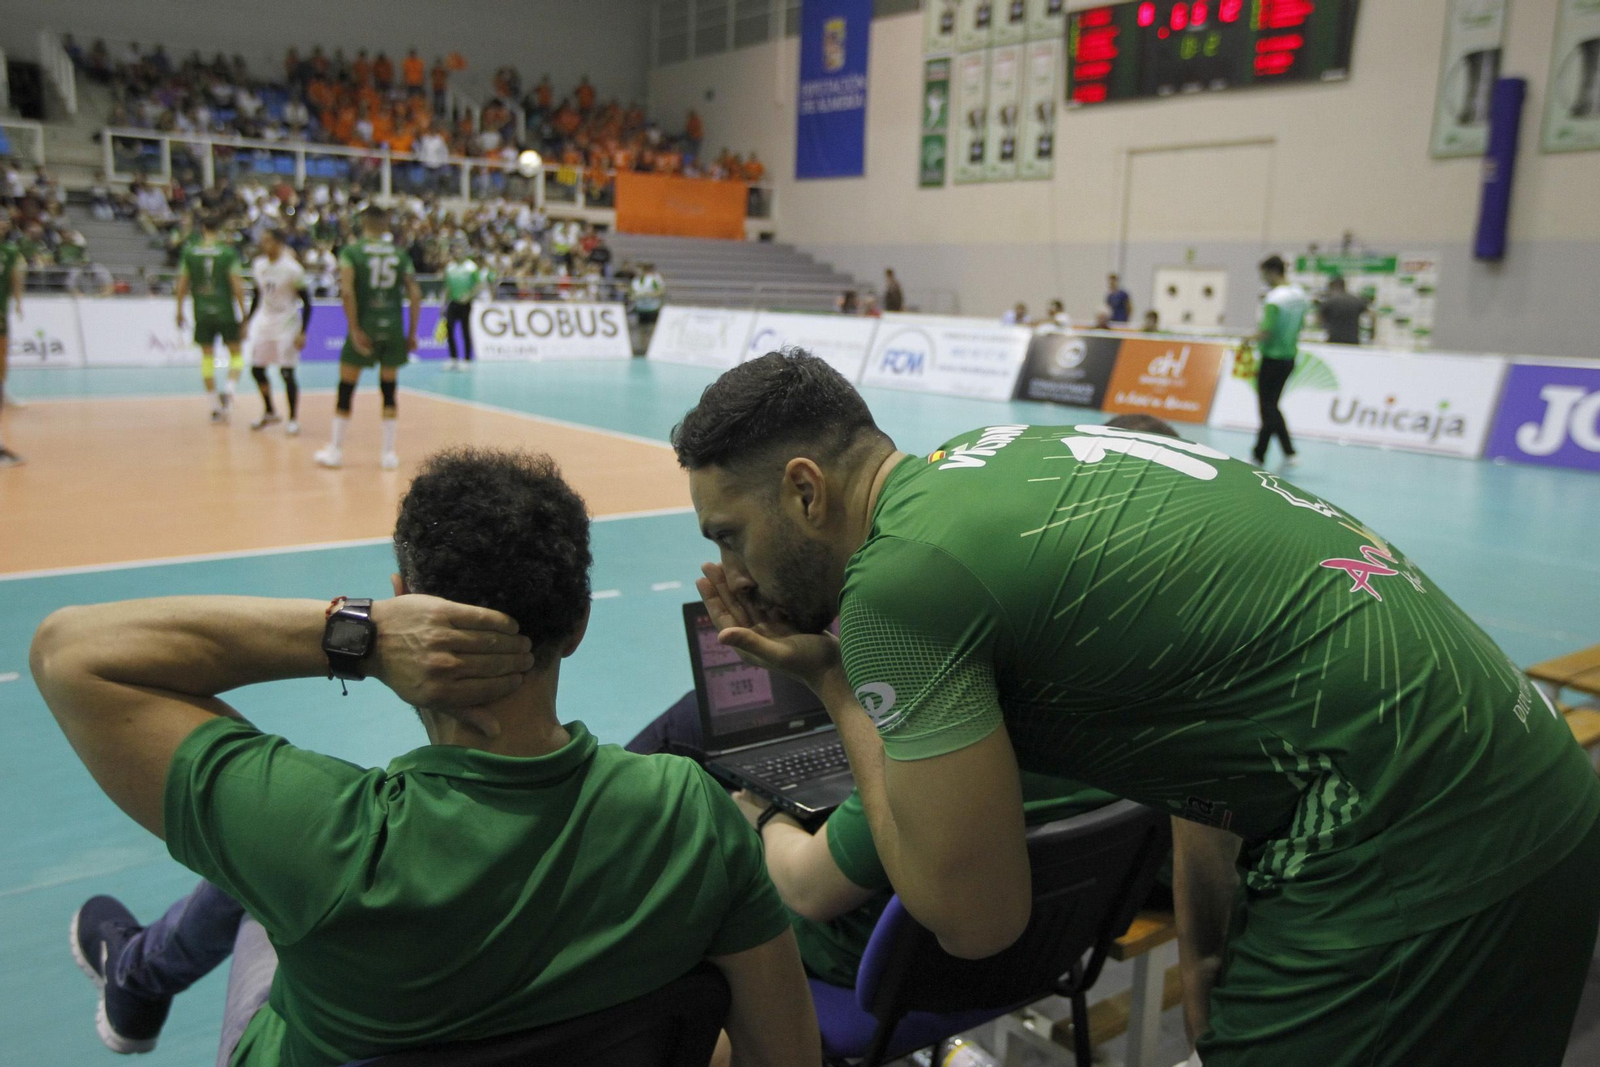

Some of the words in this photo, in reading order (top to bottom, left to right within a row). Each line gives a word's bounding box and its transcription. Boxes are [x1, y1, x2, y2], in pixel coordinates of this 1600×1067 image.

[367, 256, 400, 288] 15
[480, 307, 619, 337] GLOBUS
[1329, 396, 1466, 442] Unicaja
